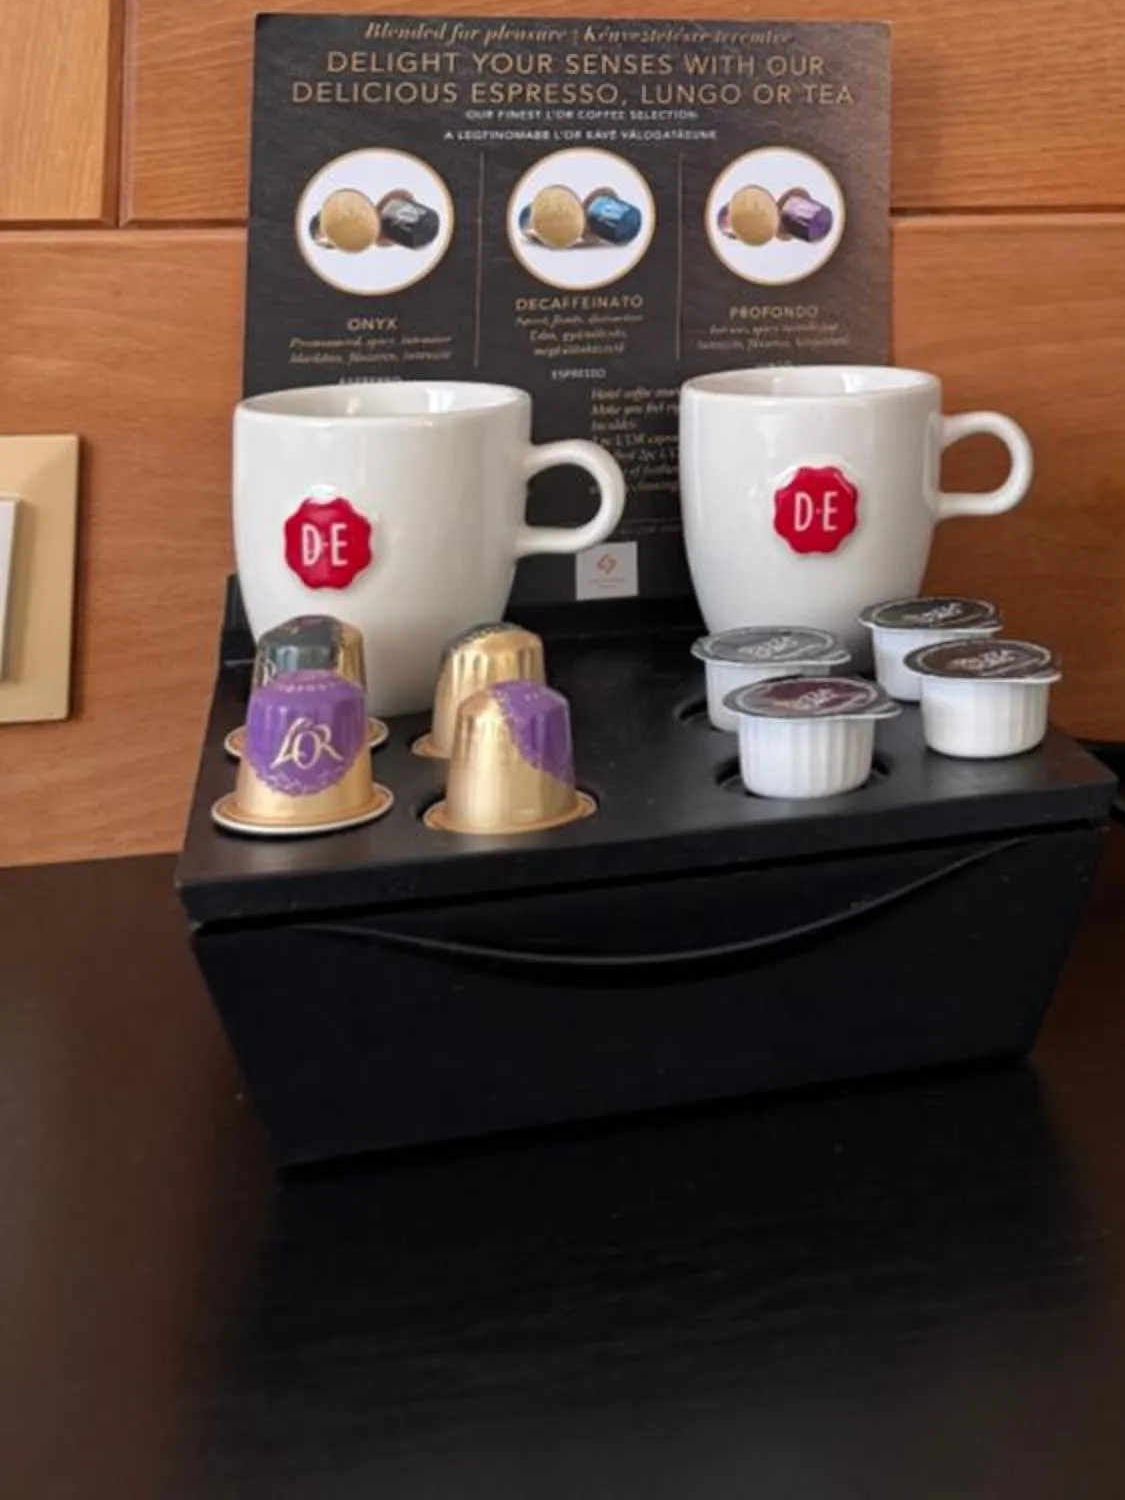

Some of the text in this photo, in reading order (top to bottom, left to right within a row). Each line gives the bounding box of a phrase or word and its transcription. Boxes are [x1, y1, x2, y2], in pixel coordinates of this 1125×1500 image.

[364, 21, 446, 40] Blended
[448, 21, 481, 46] for
[484, 24, 567, 47] pleasure
[327, 51, 825, 77] DELIGHT YOUR SENSES WITH OUR
[292, 81, 855, 107] DELICIOUS ESPRESSO, LUNGO OR TEA
[465, 108, 493, 120] OUR
[497, 108, 541, 120] FINEST
[577, 108, 624, 120] COFFEE
[629, 108, 699, 120] SELECTION
[443, 130, 454, 140] A
[515, 294, 644, 311] DECAFFEINATO
[729, 305, 819, 319] PROFONDO
[346, 317, 398, 331] ONYX
